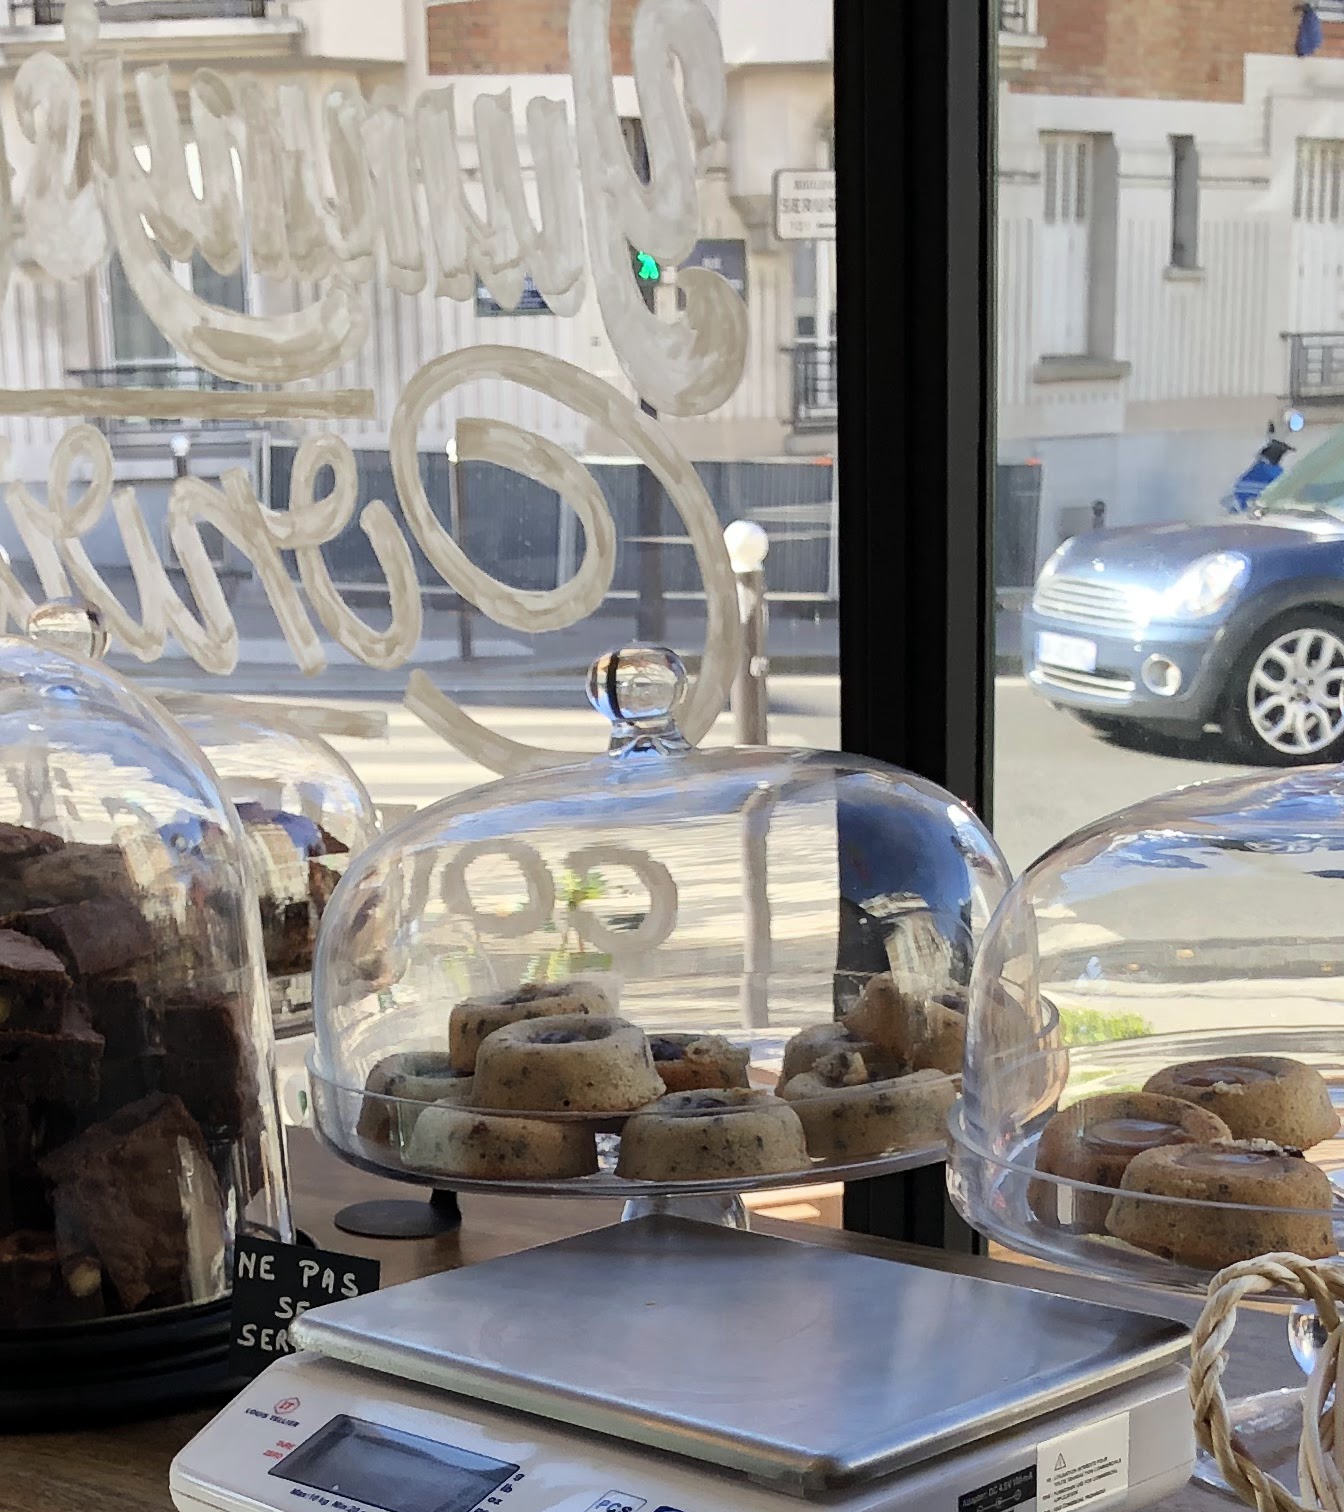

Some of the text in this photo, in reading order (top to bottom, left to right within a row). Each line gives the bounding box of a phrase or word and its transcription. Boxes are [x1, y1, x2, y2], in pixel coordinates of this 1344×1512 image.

[237, 1250, 360, 1298] NE PAS
[236, 1322, 290, 1353] SER
